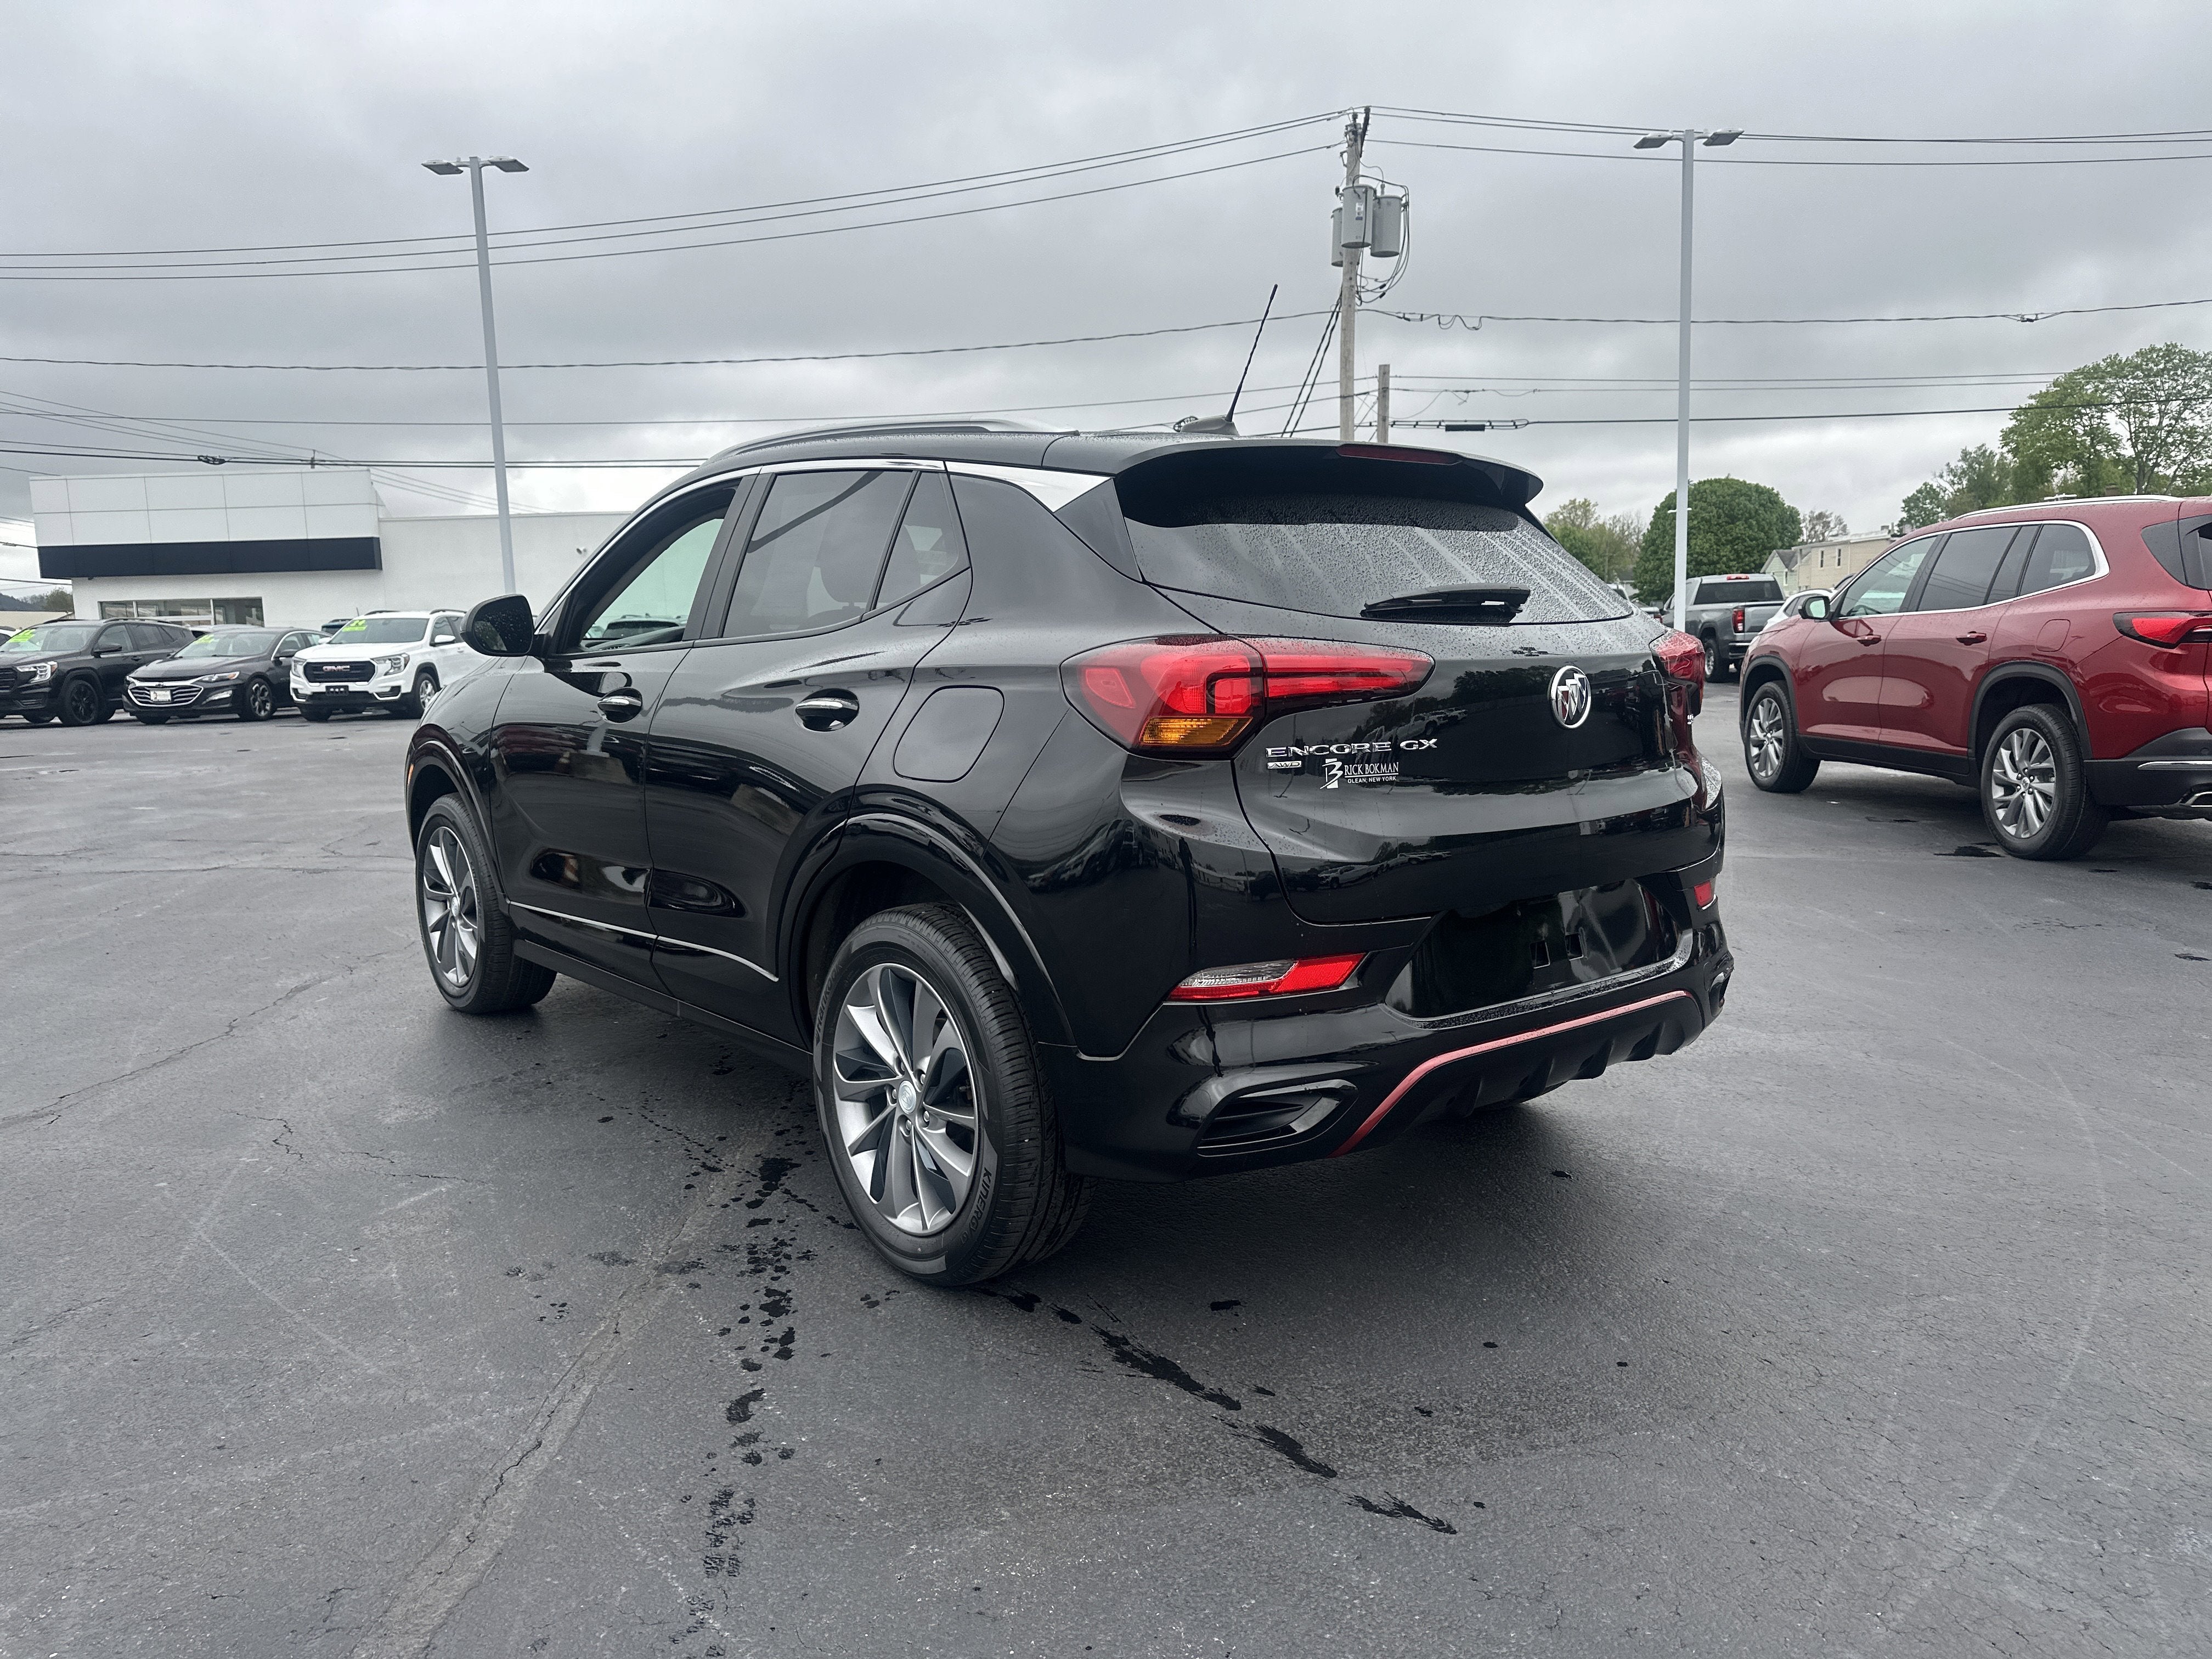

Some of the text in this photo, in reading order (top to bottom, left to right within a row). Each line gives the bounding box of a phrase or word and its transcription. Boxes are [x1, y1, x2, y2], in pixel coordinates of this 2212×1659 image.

[1265, 738, 1438, 758] ENCORE GX
[1344, 761, 1399, 776] RICK BOKMAN
